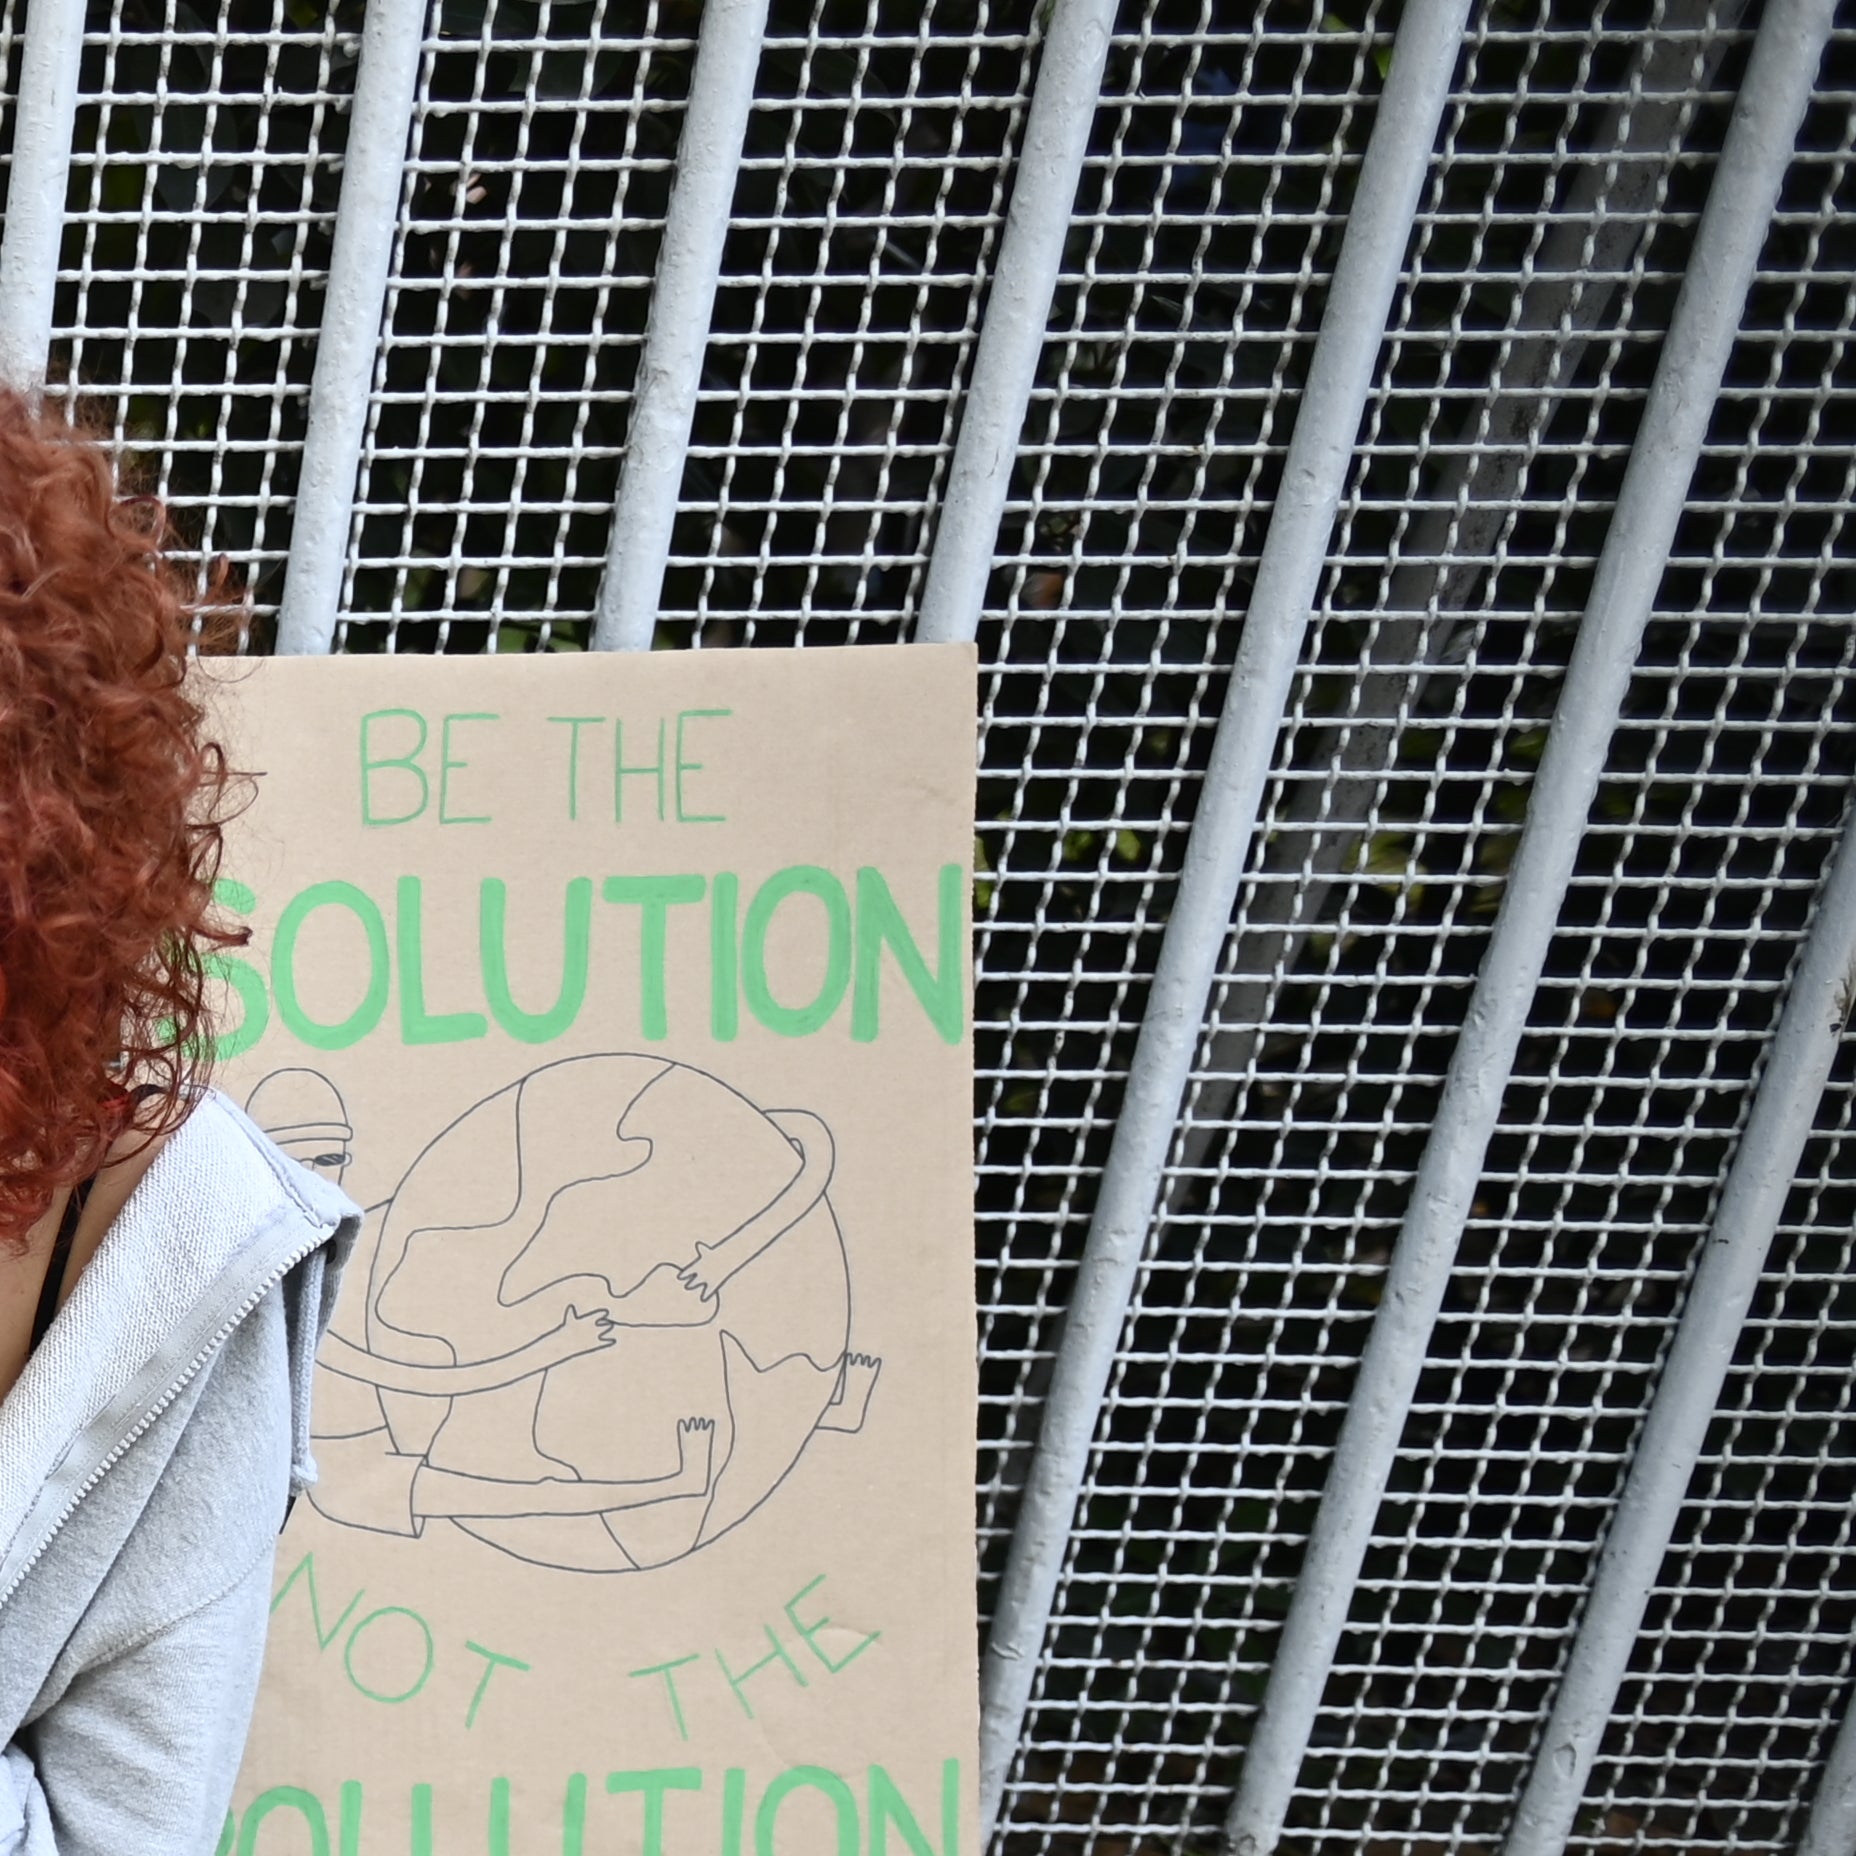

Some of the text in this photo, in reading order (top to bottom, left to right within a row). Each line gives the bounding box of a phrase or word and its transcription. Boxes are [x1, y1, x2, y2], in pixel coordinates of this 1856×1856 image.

[359, 707, 734, 829] BE THE
[268, 1551, 883, 1742] NOT THE
